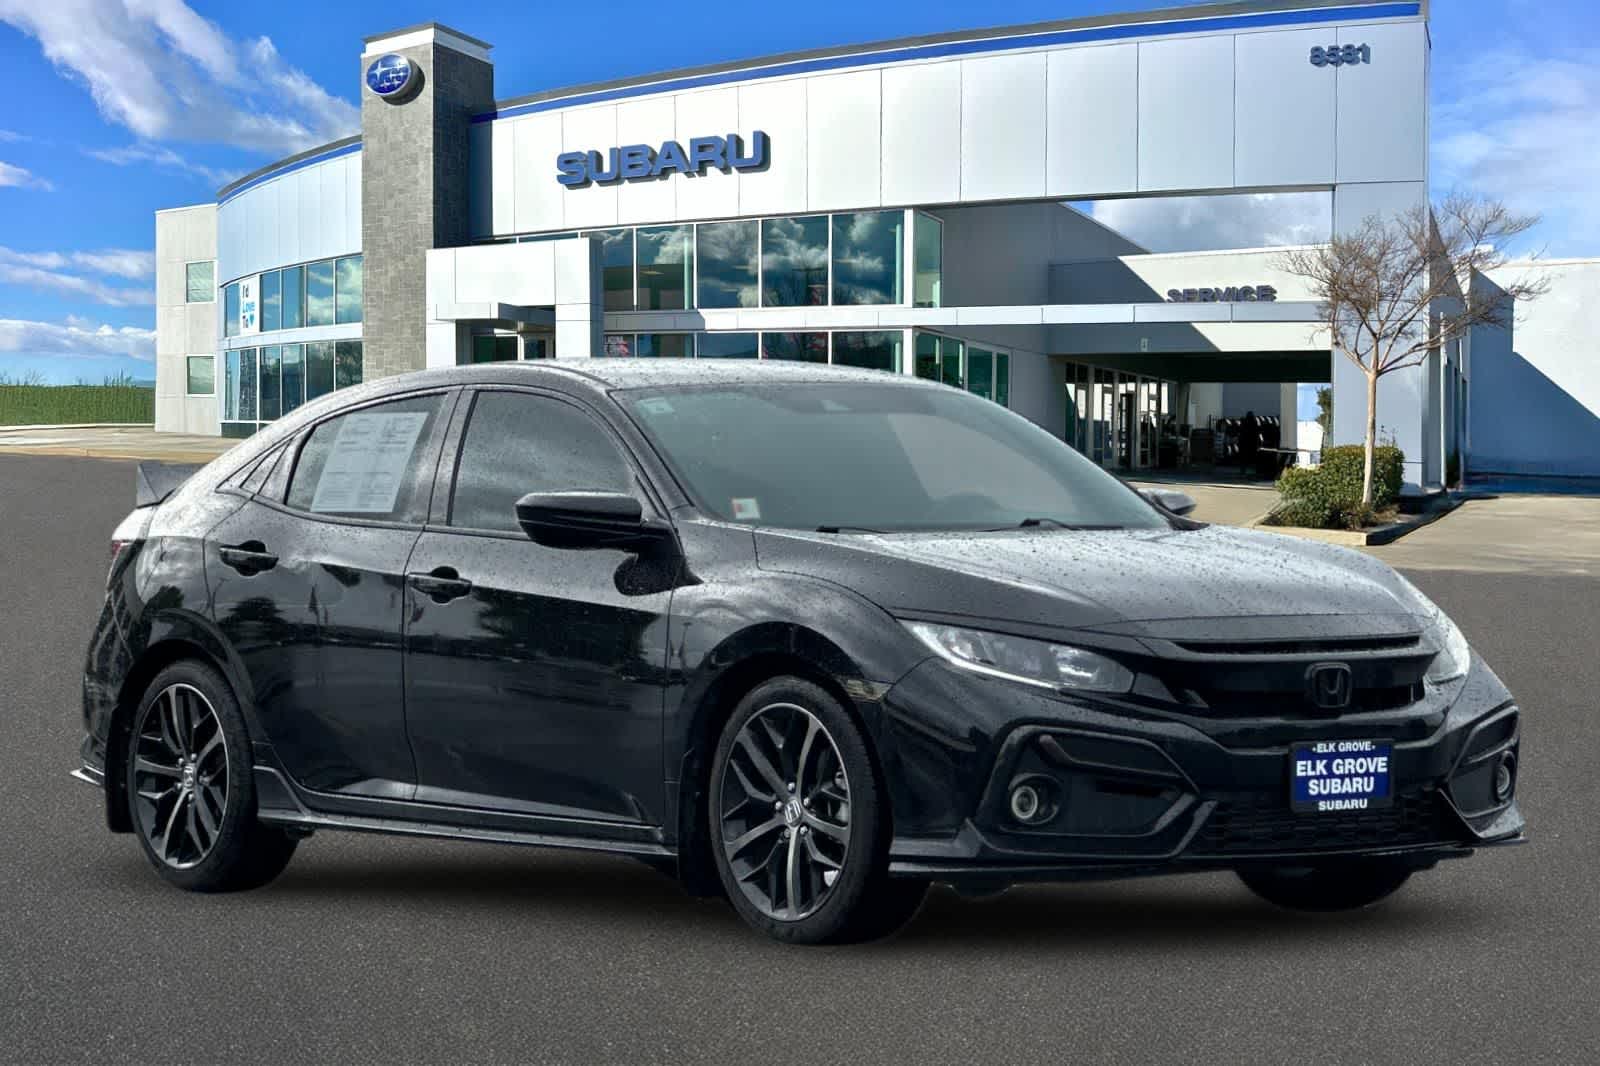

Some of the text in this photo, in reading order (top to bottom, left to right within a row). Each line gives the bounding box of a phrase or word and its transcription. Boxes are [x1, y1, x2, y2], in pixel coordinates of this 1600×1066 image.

[556, 130, 769, 187] SUBARU
[1167, 285, 1277, 302] SERVICE
[1296, 757, 1388, 776] ELK GROVE
[1308, 776, 1374, 795] SUBARU
[1318, 798, 1368, 811] SUBARU
